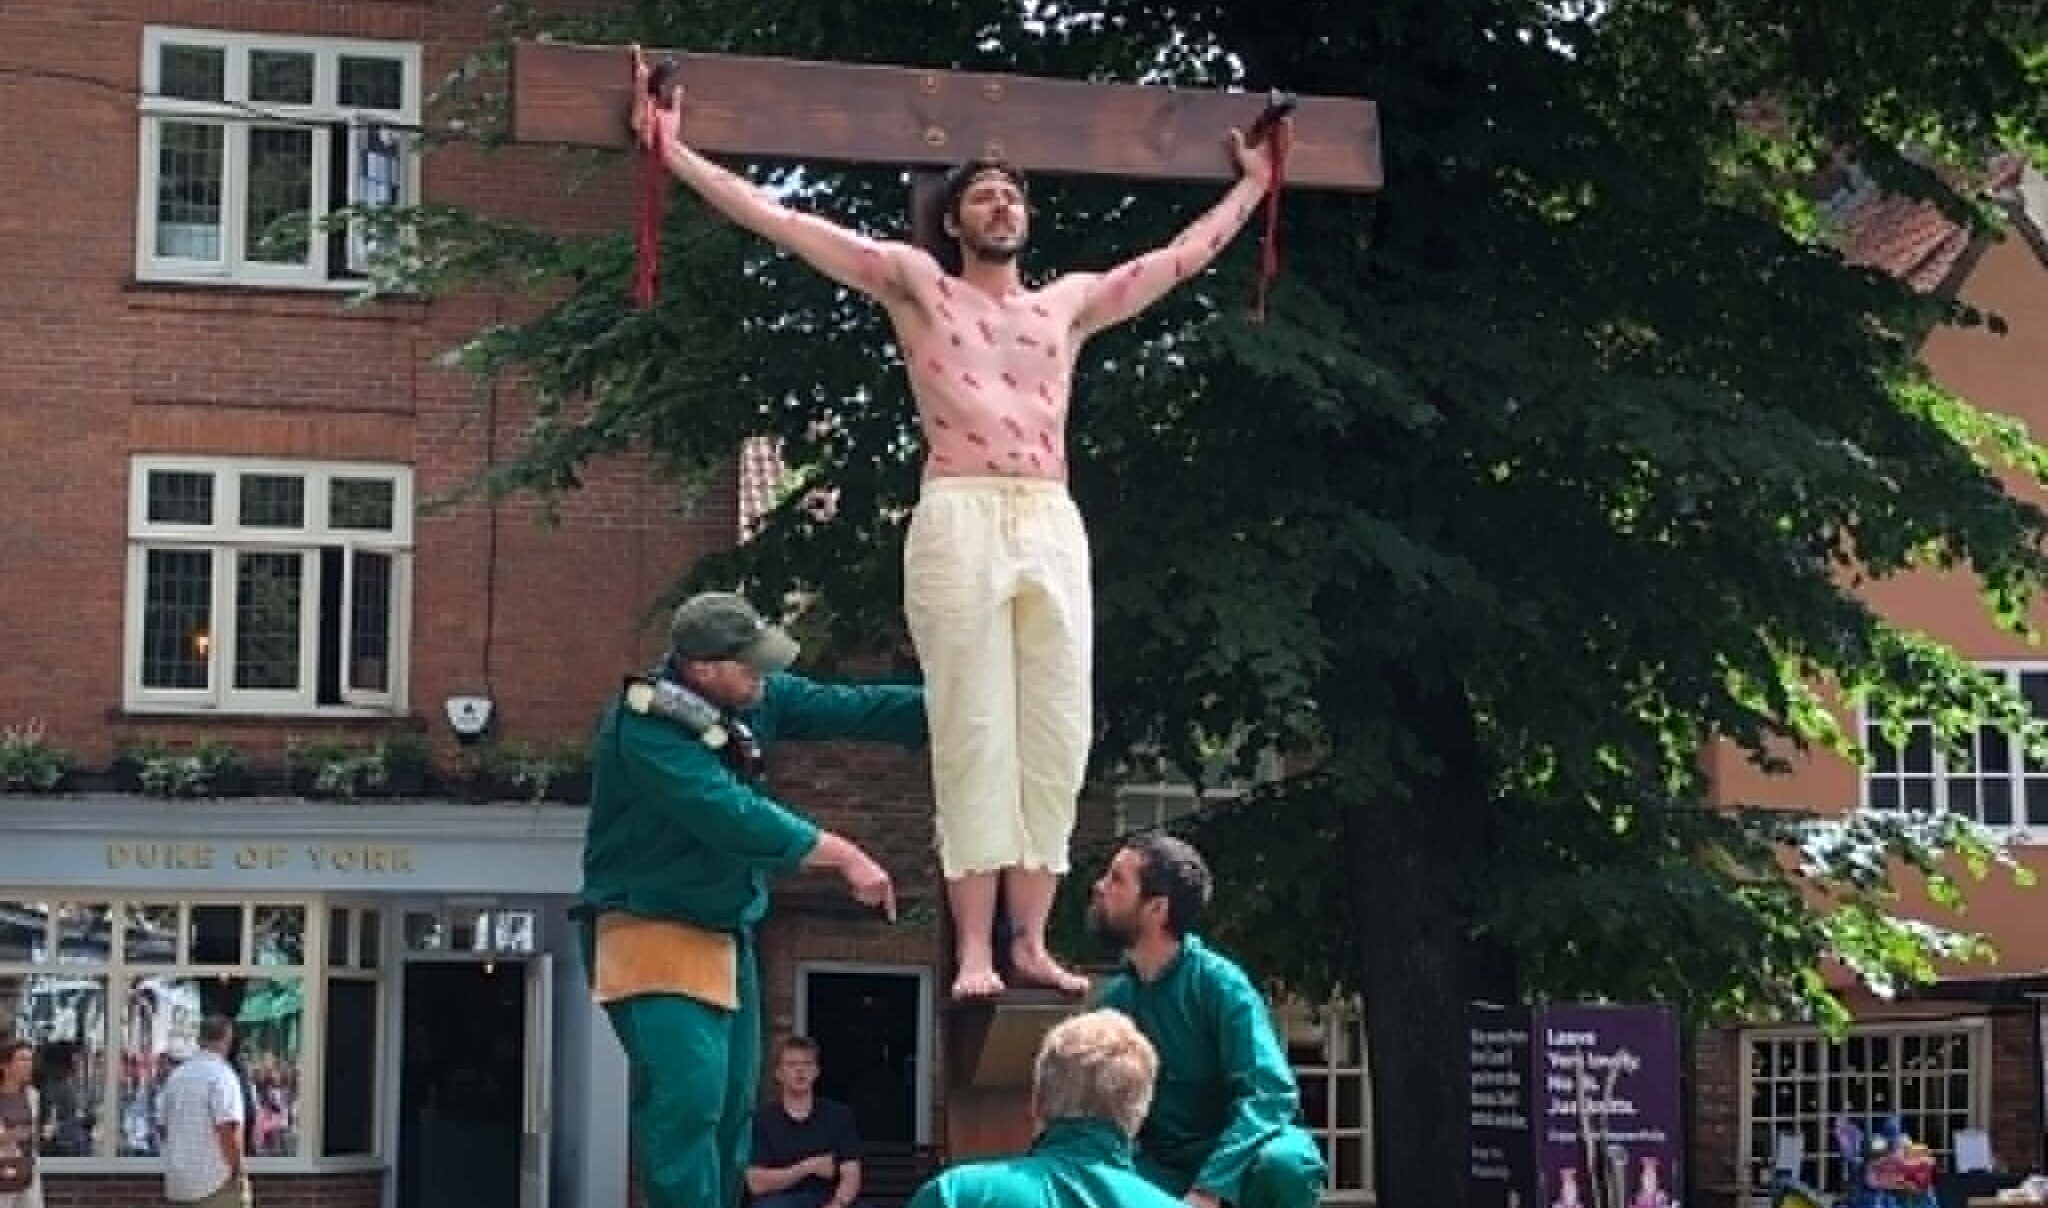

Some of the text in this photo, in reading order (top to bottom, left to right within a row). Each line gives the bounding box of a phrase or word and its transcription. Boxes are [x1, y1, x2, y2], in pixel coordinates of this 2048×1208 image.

[105, 842, 417, 874] DUKE OF YORK
